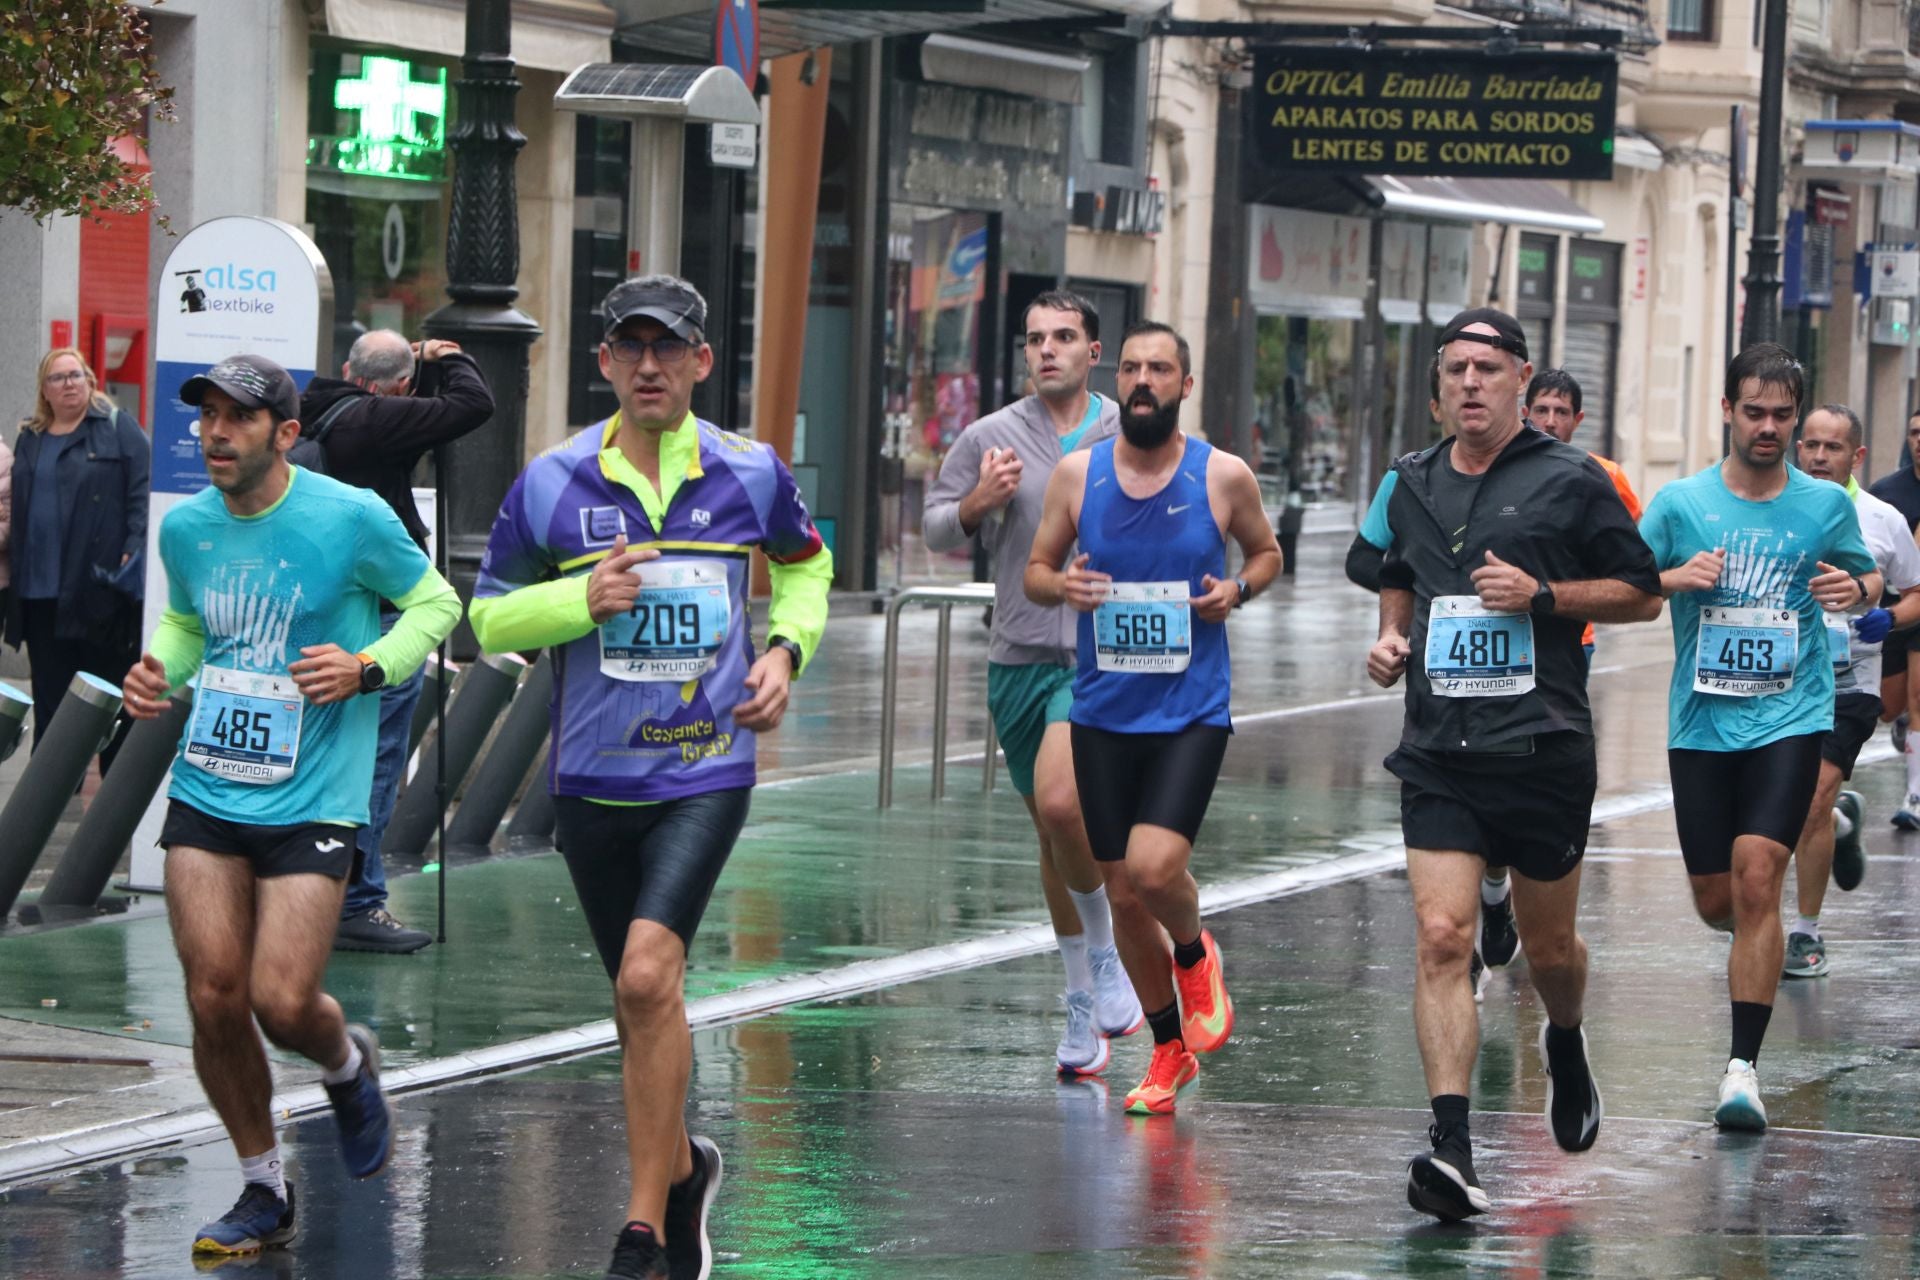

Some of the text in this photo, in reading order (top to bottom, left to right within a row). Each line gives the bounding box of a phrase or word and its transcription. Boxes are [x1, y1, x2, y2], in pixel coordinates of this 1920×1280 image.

[1265, 70, 1602, 101] OPTICA Emilia Barriada
[1272, 107, 1594, 134] APARATOS PARA SORDOS
[1292, 138, 1570, 165] LENTES DE CONTACTO
[204, 263, 276, 291] alsa
[205, 297, 274, 314] nextbike
[630, 603, 700, 646] 209
[1115, 614, 1166, 645] 569
[1448, 630, 1509, 666] 480
[1718, 638, 1774, 671] 463
[650, 661, 706, 672] HYUNDA
[1129, 658, 1174, 666] HYUNDAI
[1465, 678, 1517, 689] HYUNDAI
[1731, 681, 1777, 690] HYUNDAI
[211, 706, 271, 751] 485
[679, 733, 731, 763] Trail
[222, 762, 273, 777] HYUNDAI
